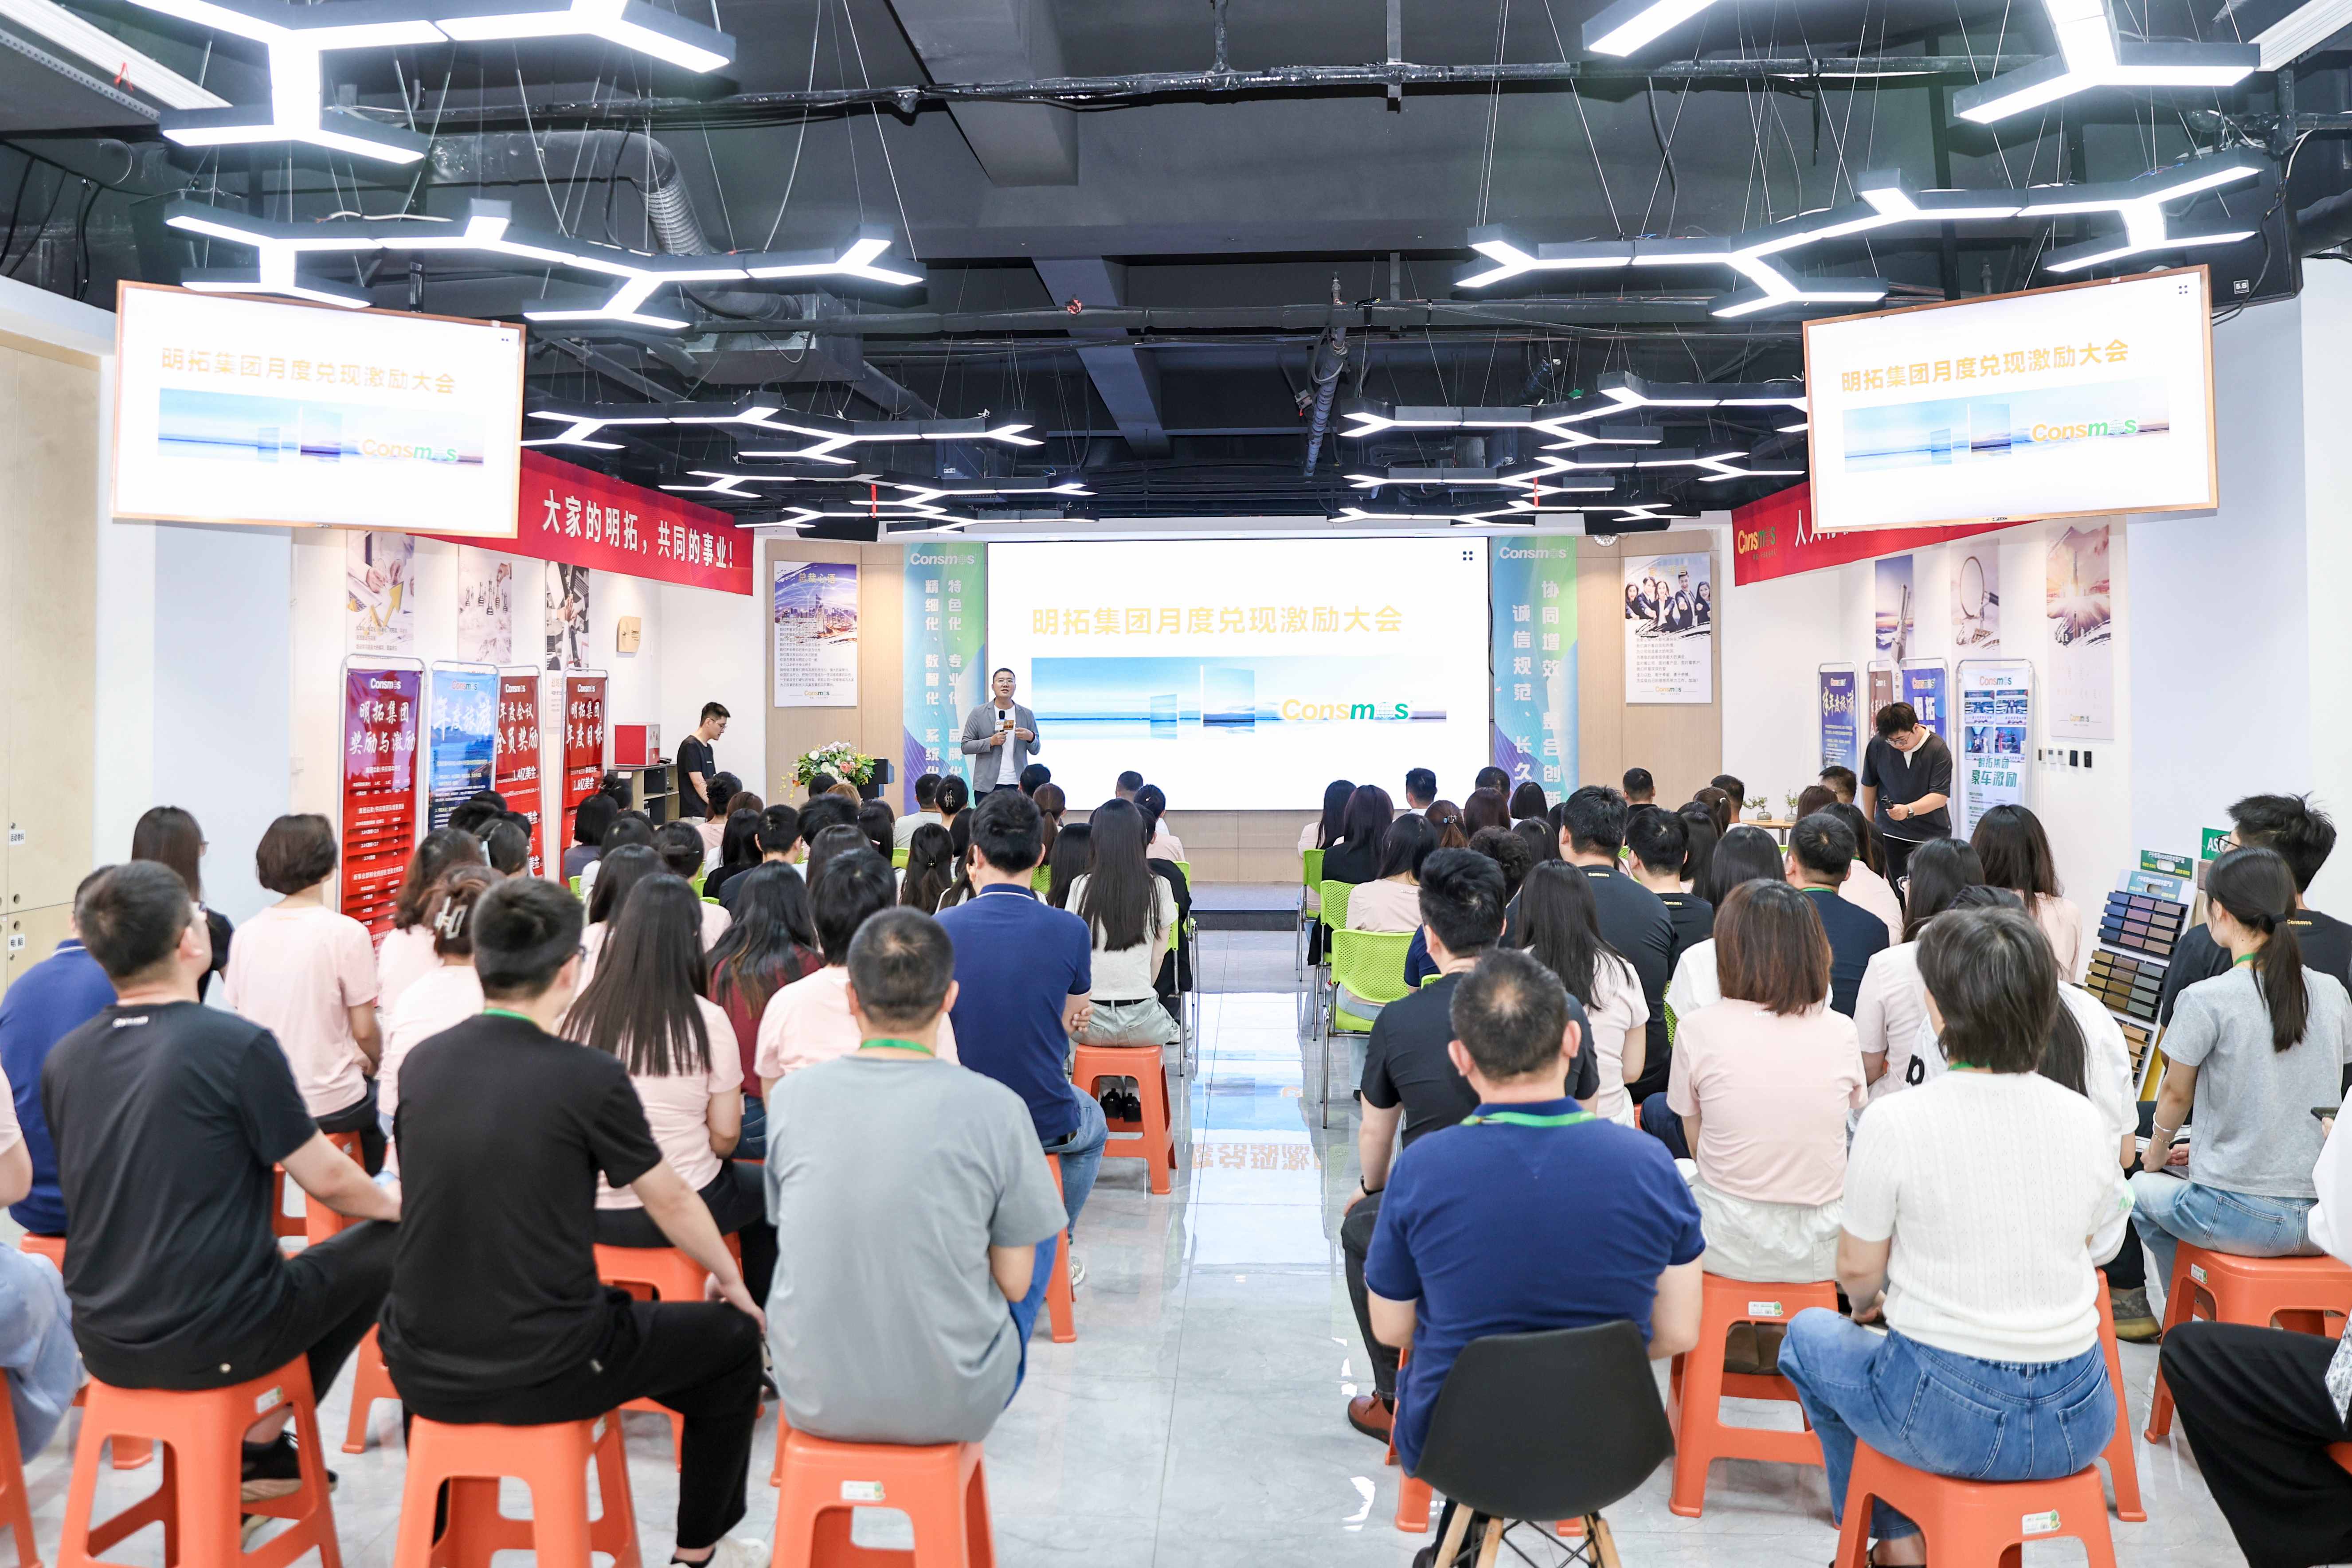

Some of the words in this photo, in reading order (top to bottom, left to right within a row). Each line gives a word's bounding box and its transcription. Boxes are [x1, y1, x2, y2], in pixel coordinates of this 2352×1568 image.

[161, 347, 455, 394] 明拓集团月度兑现激励大会
[1842, 339, 2129, 392] 明拓集团月度兑现激励大会
[910, 553, 974, 565] Consmos
[1499, 547, 1566, 559] Consmos
[798, 573, 836, 584] 总裁心语
[1032, 605, 1403, 635] 明拓集团月度兑现激励大会
[360, 700, 409, 724] 明拓集团
[499, 701, 534, 723] 年度会议
[571, 700, 600, 719] 明拓集团
[349, 731, 416, 755] 奖励与激励
[497, 726, 539, 754] 全员奖励
[566, 723, 603, 751] 年度目标
[573, 776, 595, 791] 1.8亿美金
[1971, 769, 2017, 788] 豪车激励
